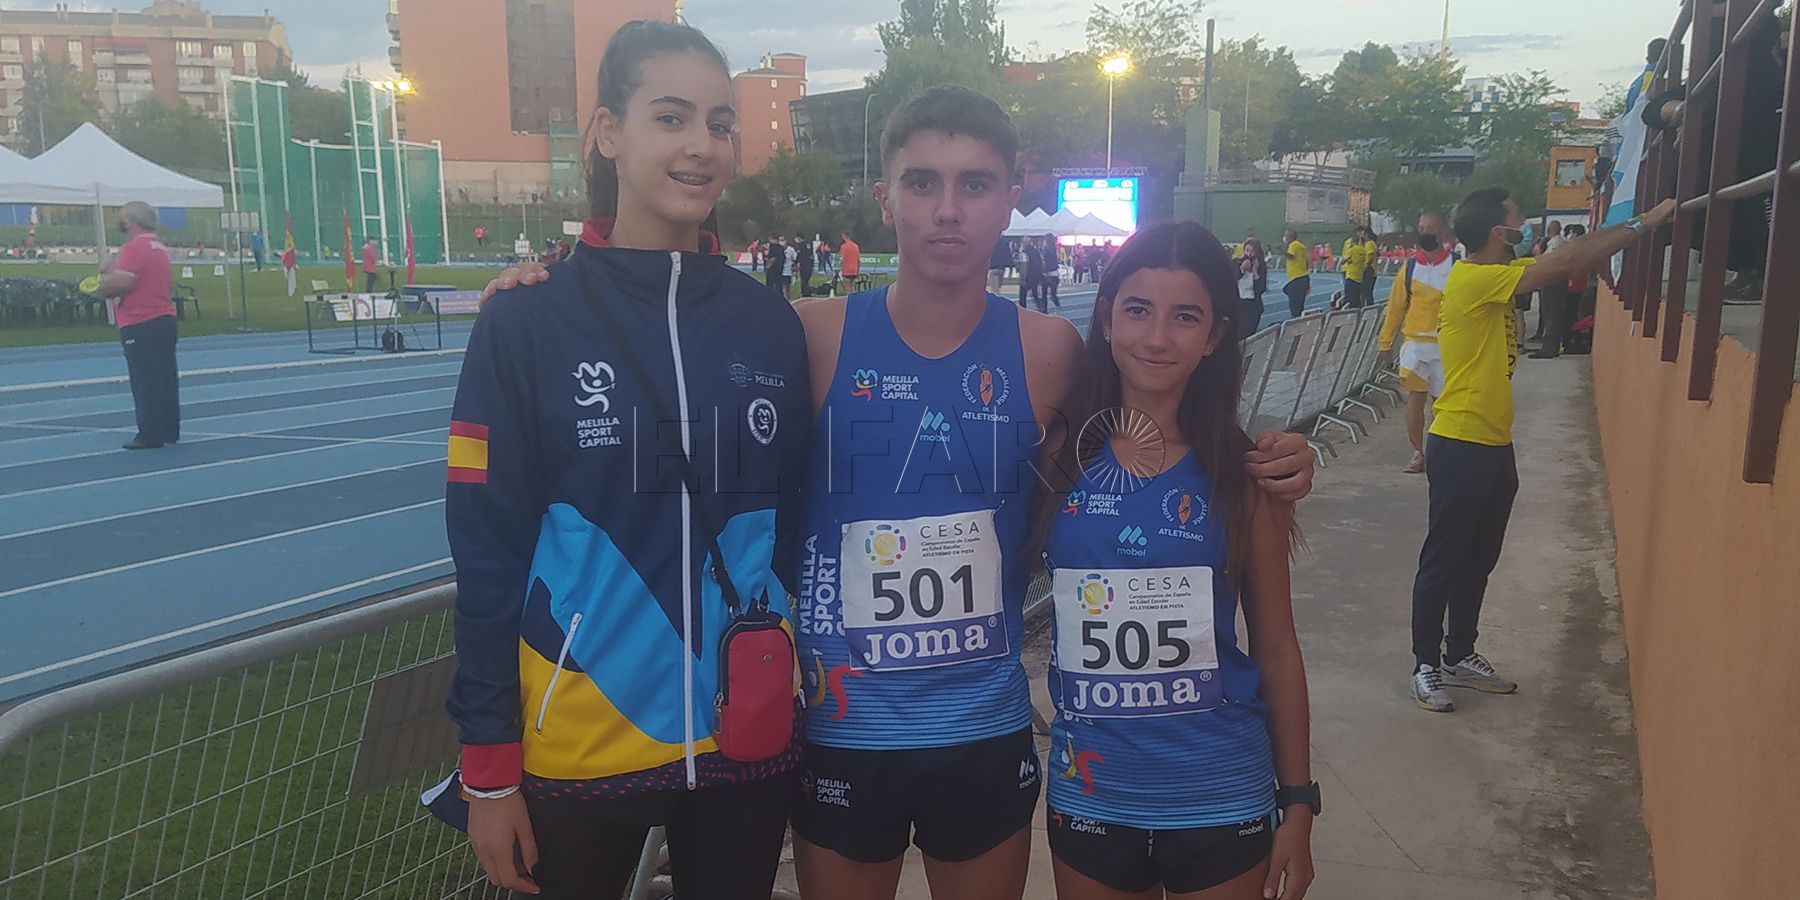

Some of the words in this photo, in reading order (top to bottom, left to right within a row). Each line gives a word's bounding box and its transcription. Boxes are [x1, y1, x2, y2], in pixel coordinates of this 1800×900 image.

[754, 375, 785, 388] MELILLA
[882, 375, 919, 384] MELILLA
[882, 383, 912, 392] SPORT
[881, 391, 919, 400] CAPITAL
[576, 416, 621, 429] MELILLA
[961, 411, 1010, 423] ATLETISMO
[577, 427, 612, 439] SPORT
[920, 433, 950, 443] mobel
[579, 436, 622, 448] CAPITAL
[1088, 493, 1122, 502] MELILLA
[1087, 500, 1116, 508] SPORT
[1086, 507, 1120, 516] CAPITAL
[920, 521, 980, 539] CESA
[1158, 528, 1204, 542] ATLETISMO
[1117, 548, 1147, 557] mobel
[800, 534, 818, 635] MELILLA
[1128, 576, 1191, 592] CESA
[814, 553, 837, 637] SPORT
[871, 564, 974, 622] 501
[1082, 619, 1191, 670] 505
[817, 778, 851, 790] MELILLA
[817, 786, 845, 797] SPORT
[817, 795, 850, 807] CAPITAL
[1070, 821, 1108, 835] CAPITAL
[1238, 823, 1264, 837] mobel
